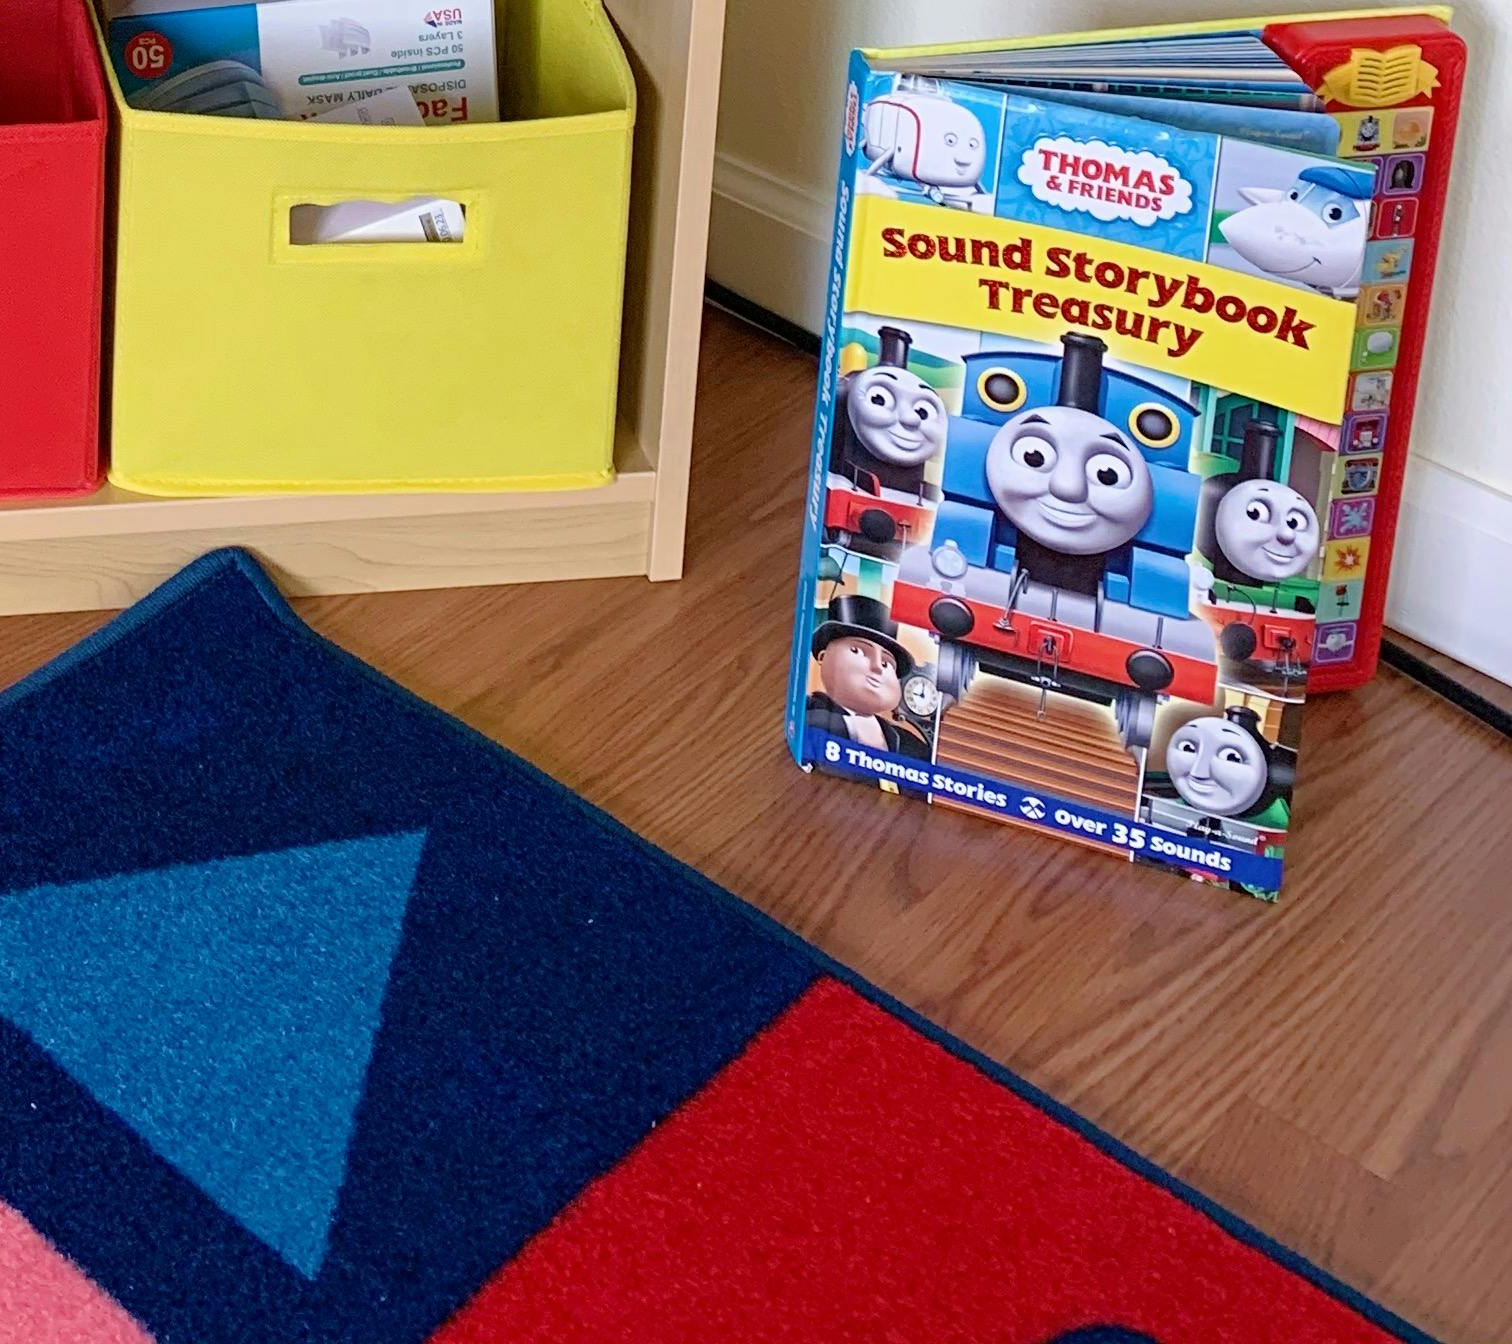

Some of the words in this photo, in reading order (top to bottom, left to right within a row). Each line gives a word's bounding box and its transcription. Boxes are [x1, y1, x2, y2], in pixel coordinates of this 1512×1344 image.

[432, 8, 462, 21] USA
[418, 31, 454, 43] Layers
[452, 43, 464, 53] 50
[457, 31, 463, 39] 3
[132, 45, 165, 70] 50
[391, 48, 423, 59] inside
[426, 46, 449, 57] PCS
[306, 92, 344, 106] MASK
[1038, 148, 1176, 196] THOMAS
[1046, 175, 1062, 192] &
[1068, 179, 1163, 212] FRIENDS
[834, 180, 851, 267] Sound
[881, 227, 1033, 273] Sound
[1044, 247, 1317, 350] Storybook
[979, 278, 1205, 358] Treasury
[819, 272, 845, 406] Storybook
[807, 413, 831, 530] Treasury
[824, 741, 840, 763] 8
[845, 748, 929, 786] Thomas
[931, 774, 1008, 808] Stories
[1055, 807, 1108, 836] Over
[1112, 822, 1146, 850] 35
[1150, 835, 1232, 872] Sounds
